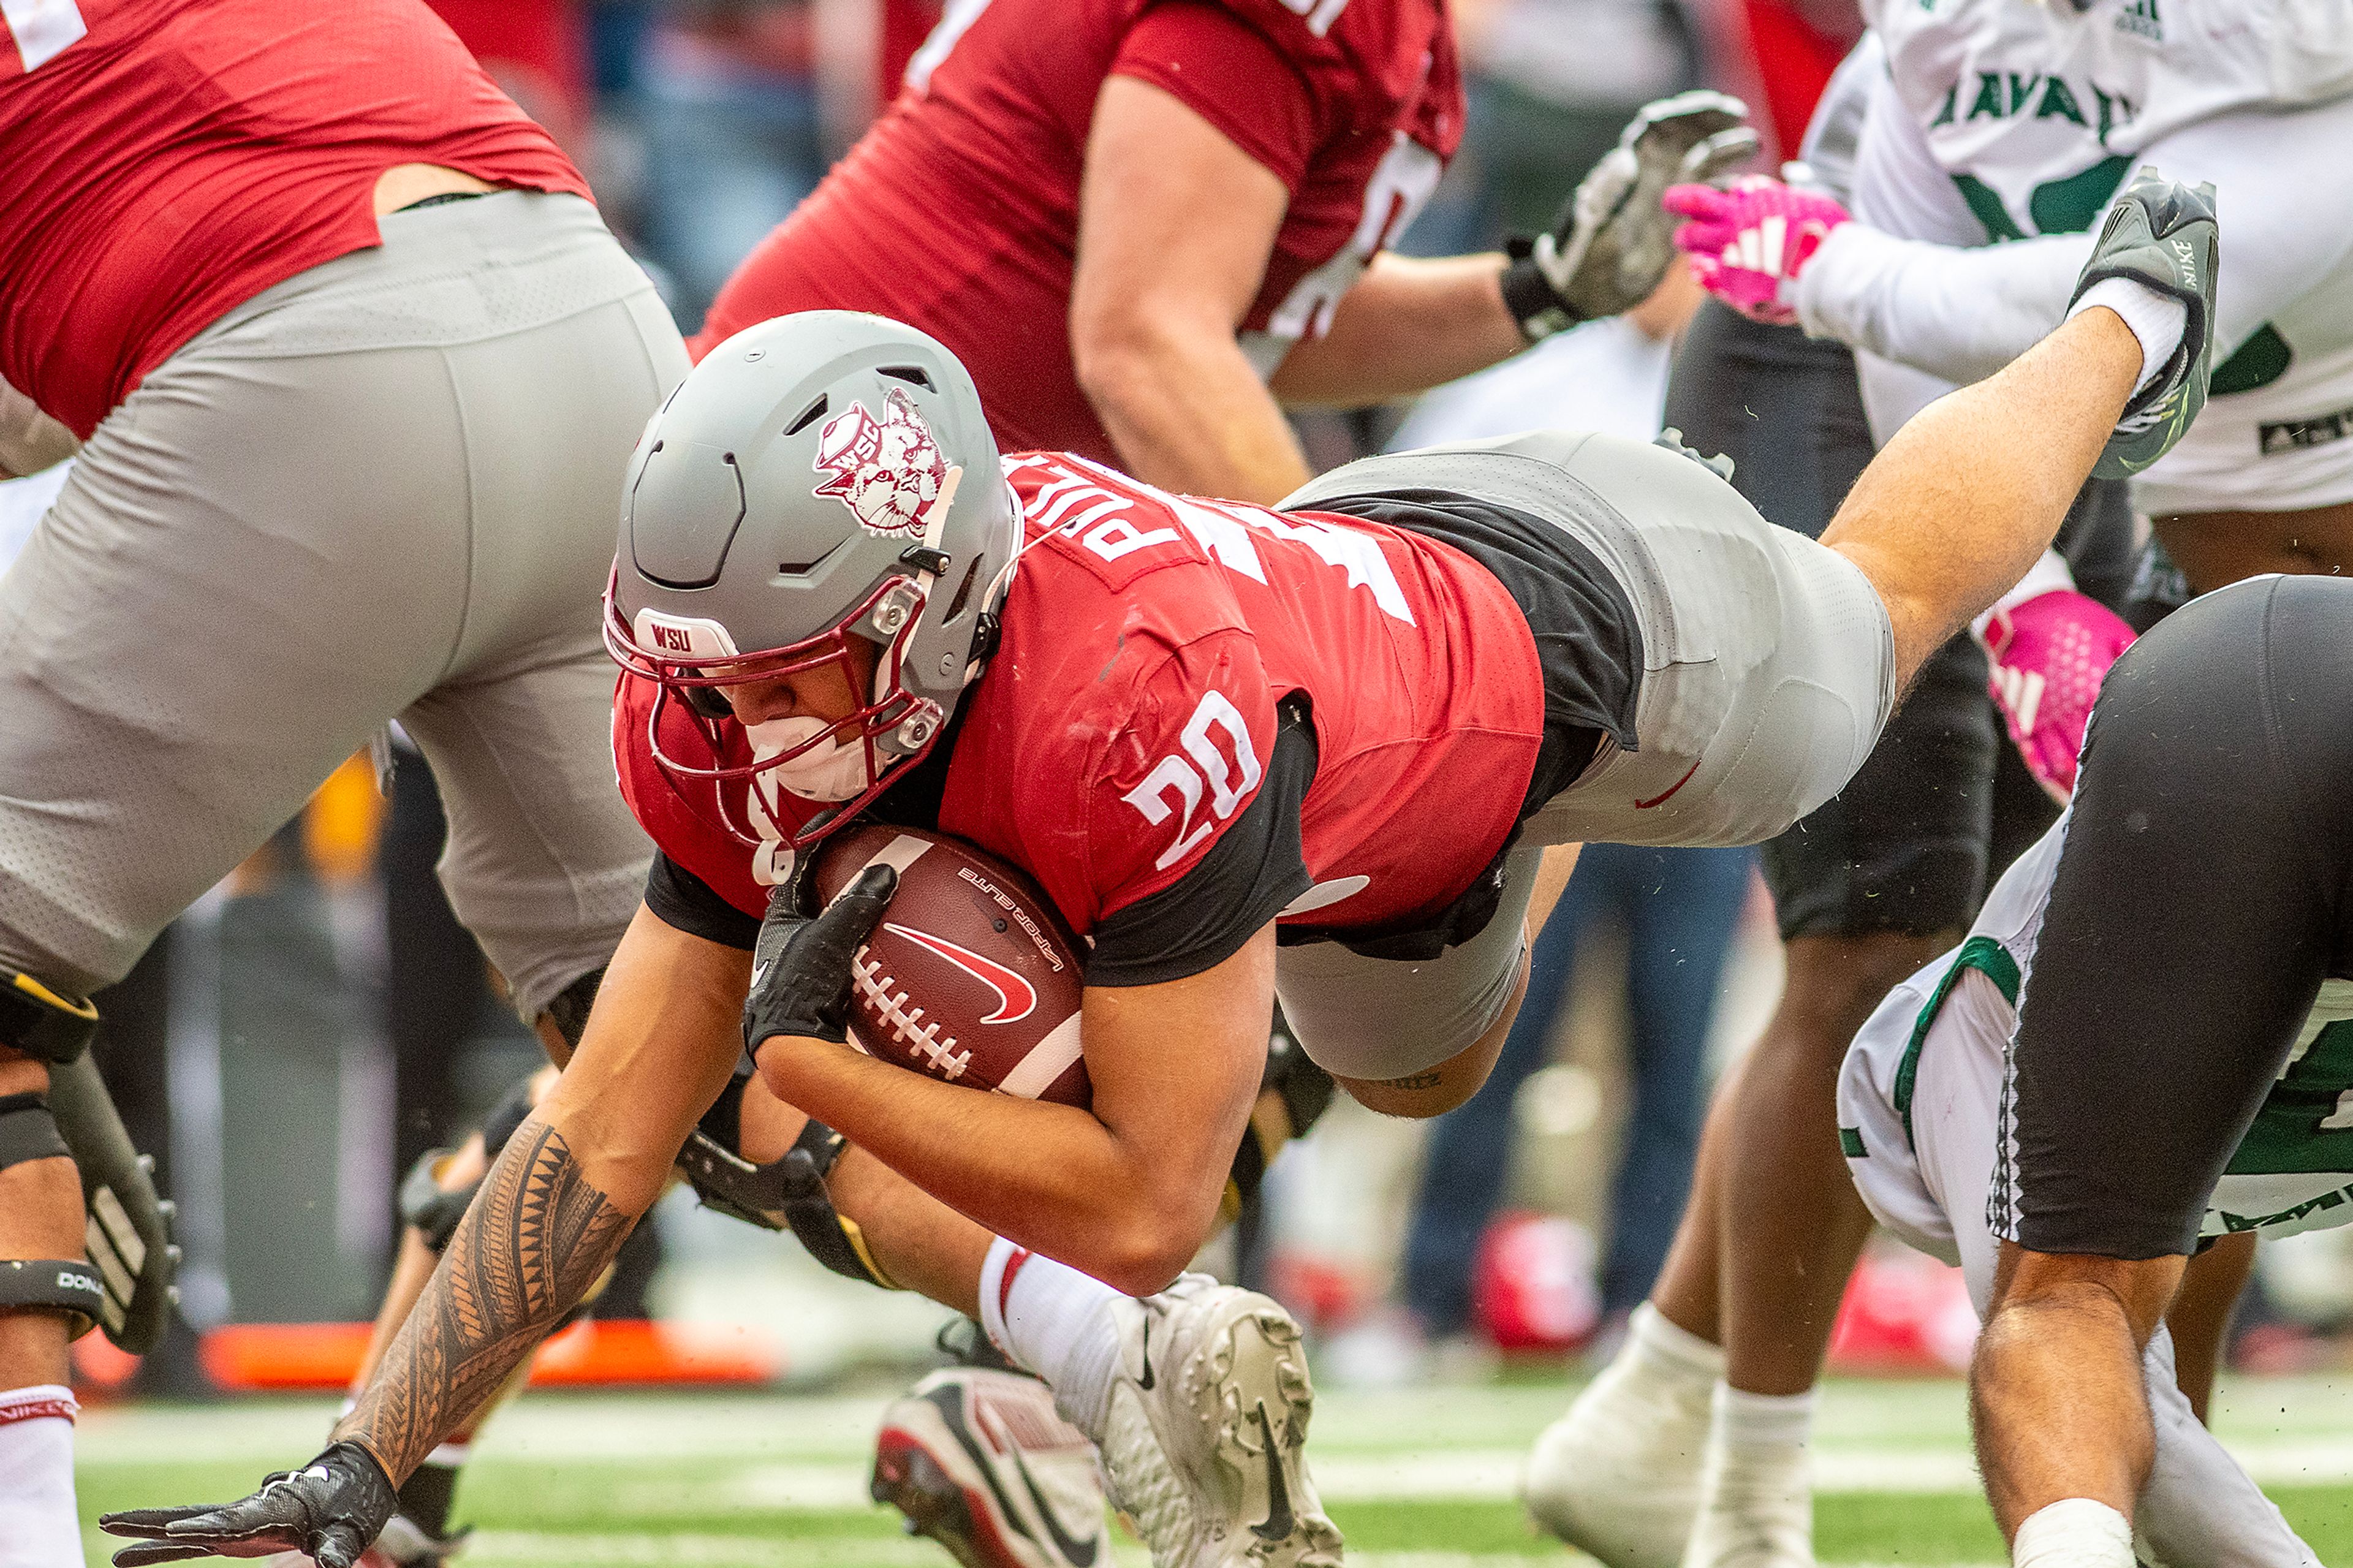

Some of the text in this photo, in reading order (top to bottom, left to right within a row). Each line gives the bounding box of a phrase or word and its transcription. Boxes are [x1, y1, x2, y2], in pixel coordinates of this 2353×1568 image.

[2171, 240, 2197, 290] NIKE
[831, 419, 879, 469] WSC
[651, 624, 692, 652] WSU
[1120, 690, 1261, 871] 20
[957, 867, 1064, 972] VAPOR ELITE
